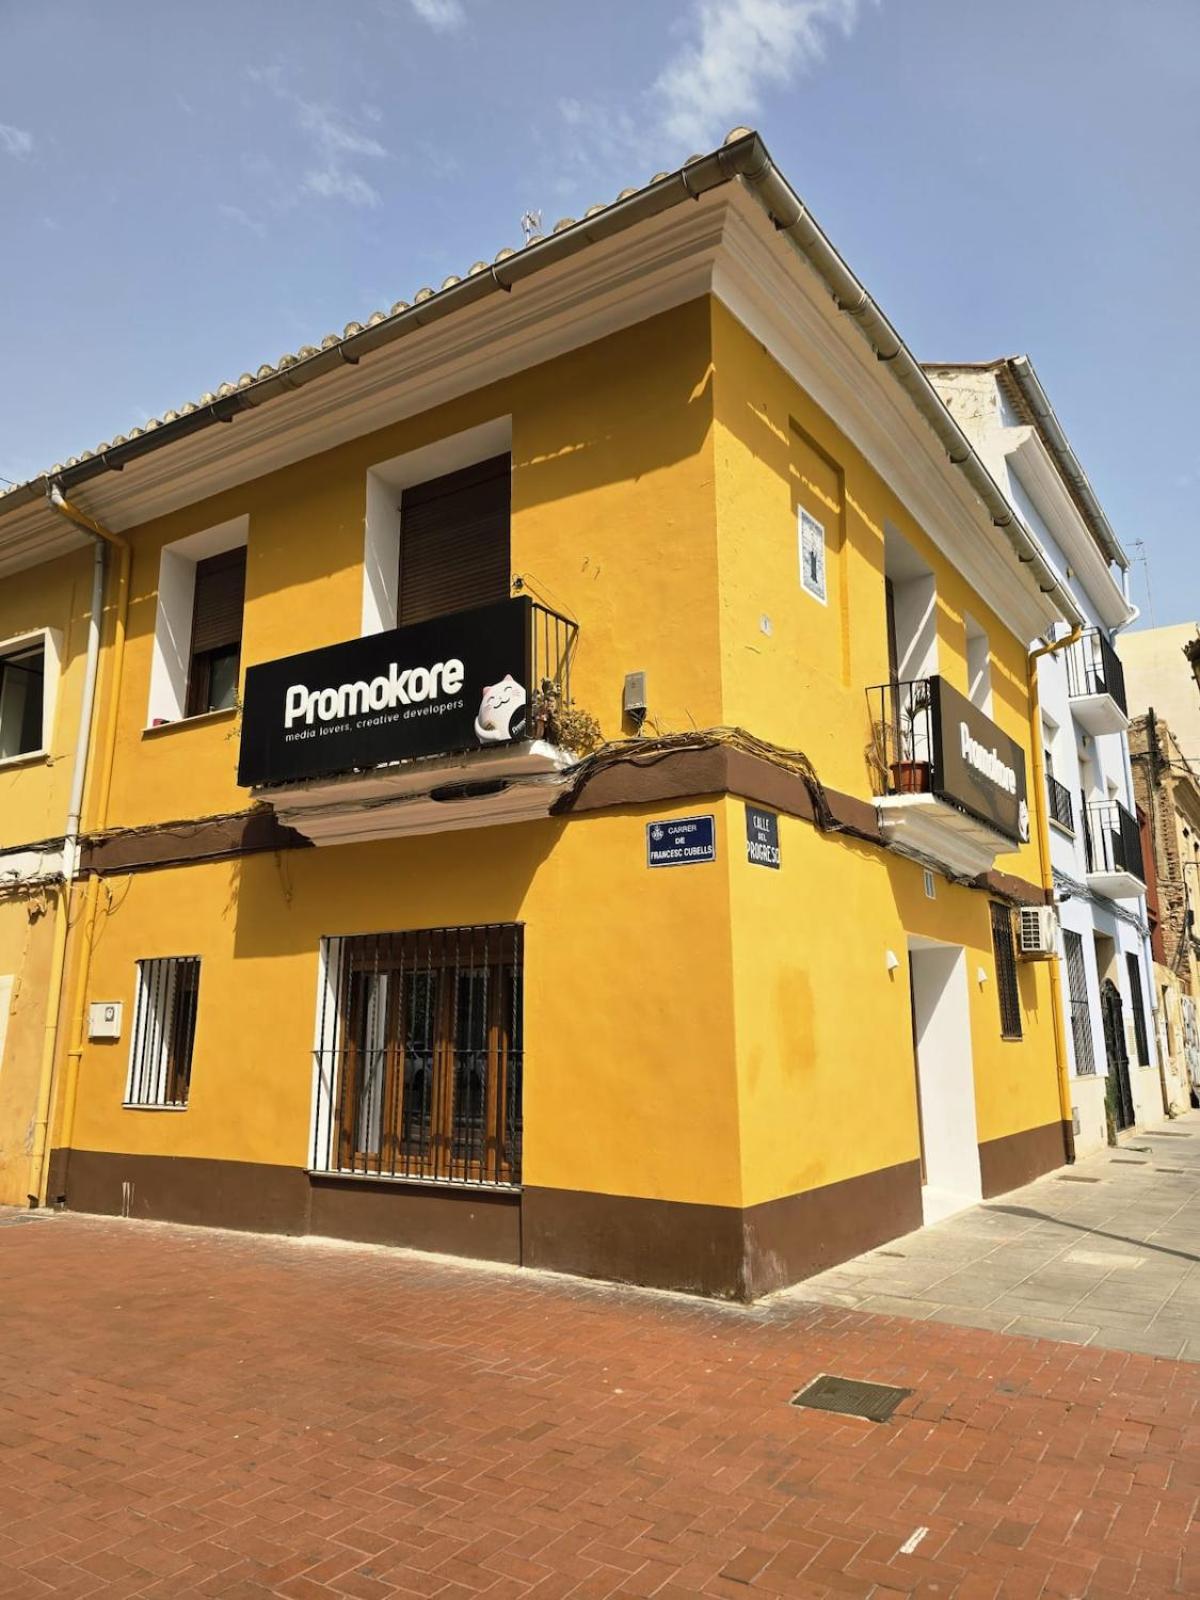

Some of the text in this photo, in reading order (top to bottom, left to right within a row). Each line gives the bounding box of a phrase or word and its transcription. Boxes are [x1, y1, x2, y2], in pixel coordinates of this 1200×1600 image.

[284, 658, 465, 728] Promokore
[285, 699, 464, 742] media lovers, creative developers
[668, 824, 697, 834] CARRER
[753, 815, 770, 832] CALLE
[675, 837, 686, 845] DE
[650, 845, 713, 860] FRANCESC CUBELLS
[747, 841, 780, 863] PROGRESO
